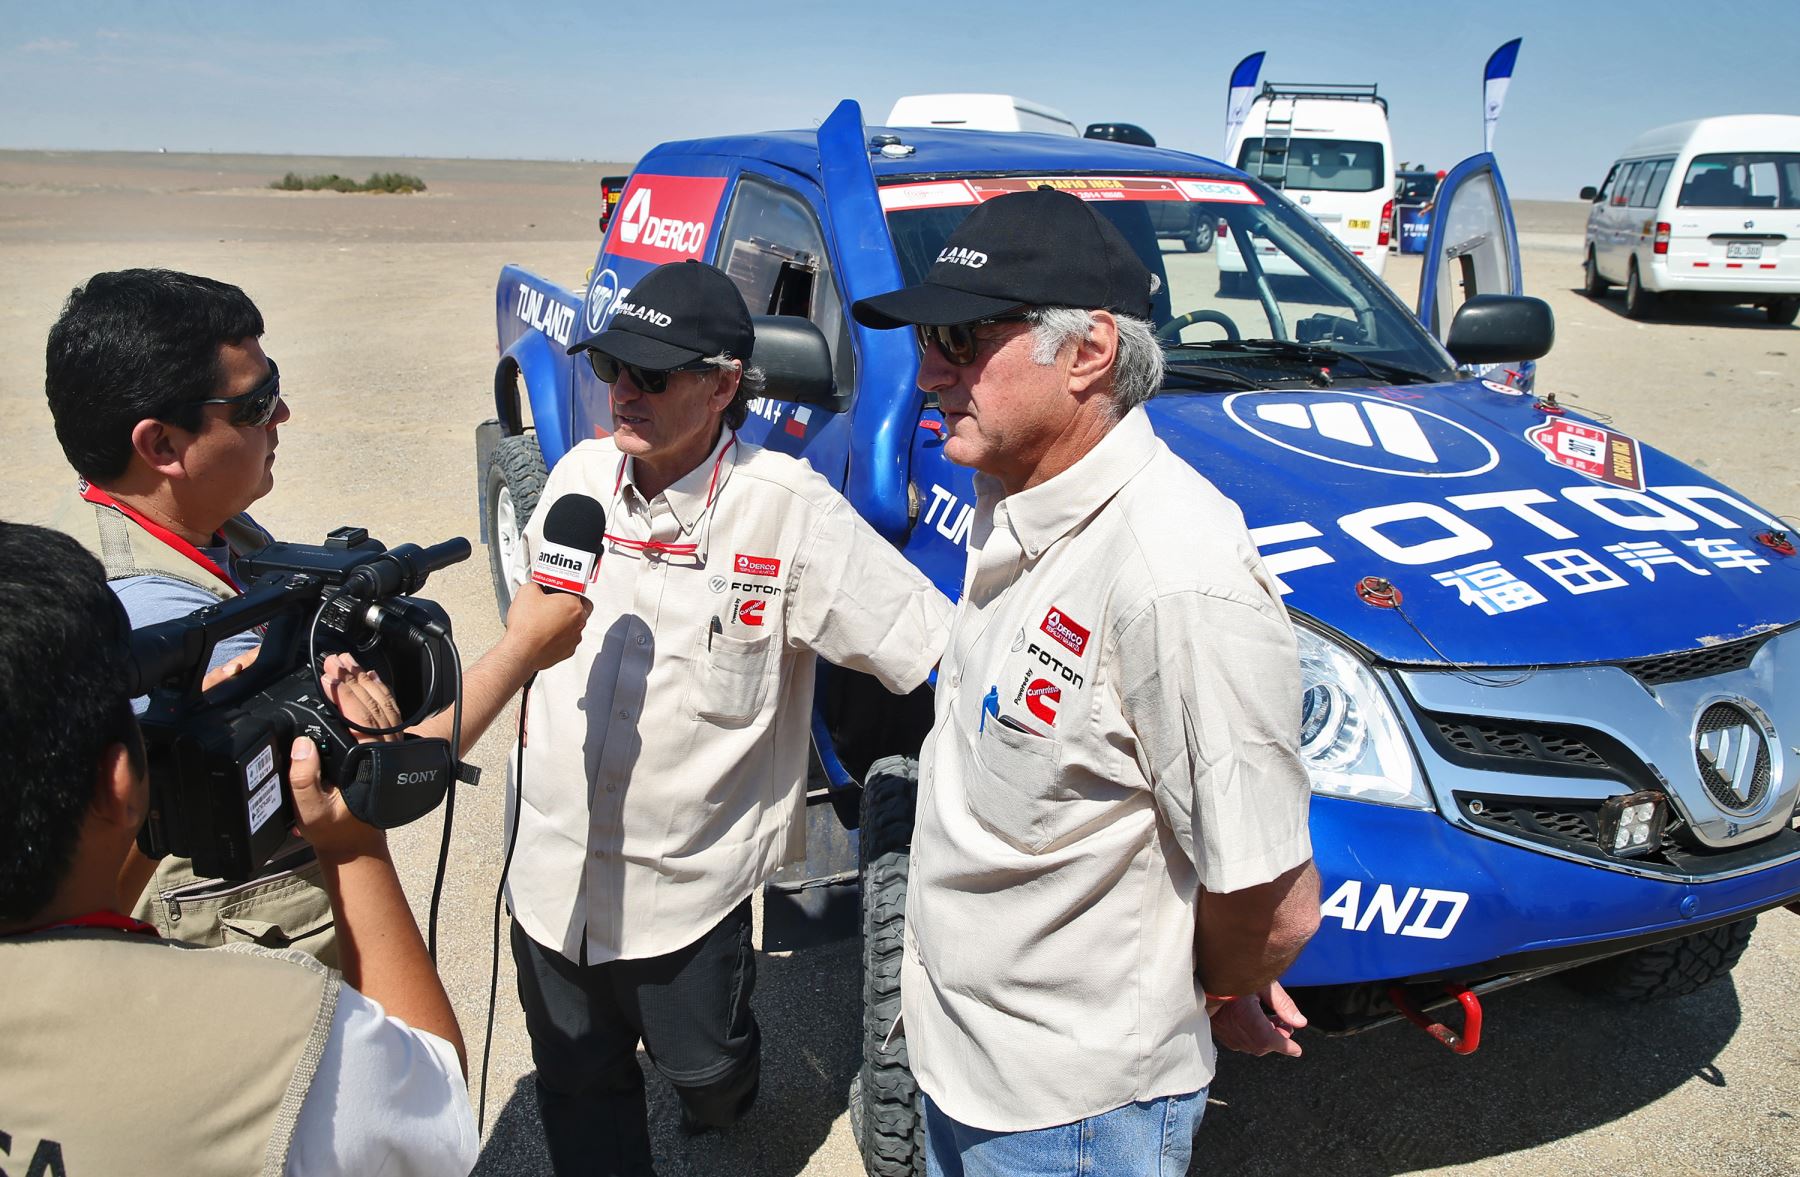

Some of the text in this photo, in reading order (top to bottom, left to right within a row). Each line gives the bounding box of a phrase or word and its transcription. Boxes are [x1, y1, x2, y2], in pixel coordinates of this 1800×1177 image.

[643, 216, 705, 254] DERCO
[516, 284, 576, 346] TUNLAND
[749, 562, 776, 571] DERCO
[1430, 537, 1772, 616] 福田汽车
[1056, 621, 1083, 647] DERCO
[1027, 643, 1084, 690] FOTON
[1013, 677, 1030, 706] Powered
[1027, 685, 1061, 697] Cummins
[396, 769, 438, 785] SONY
